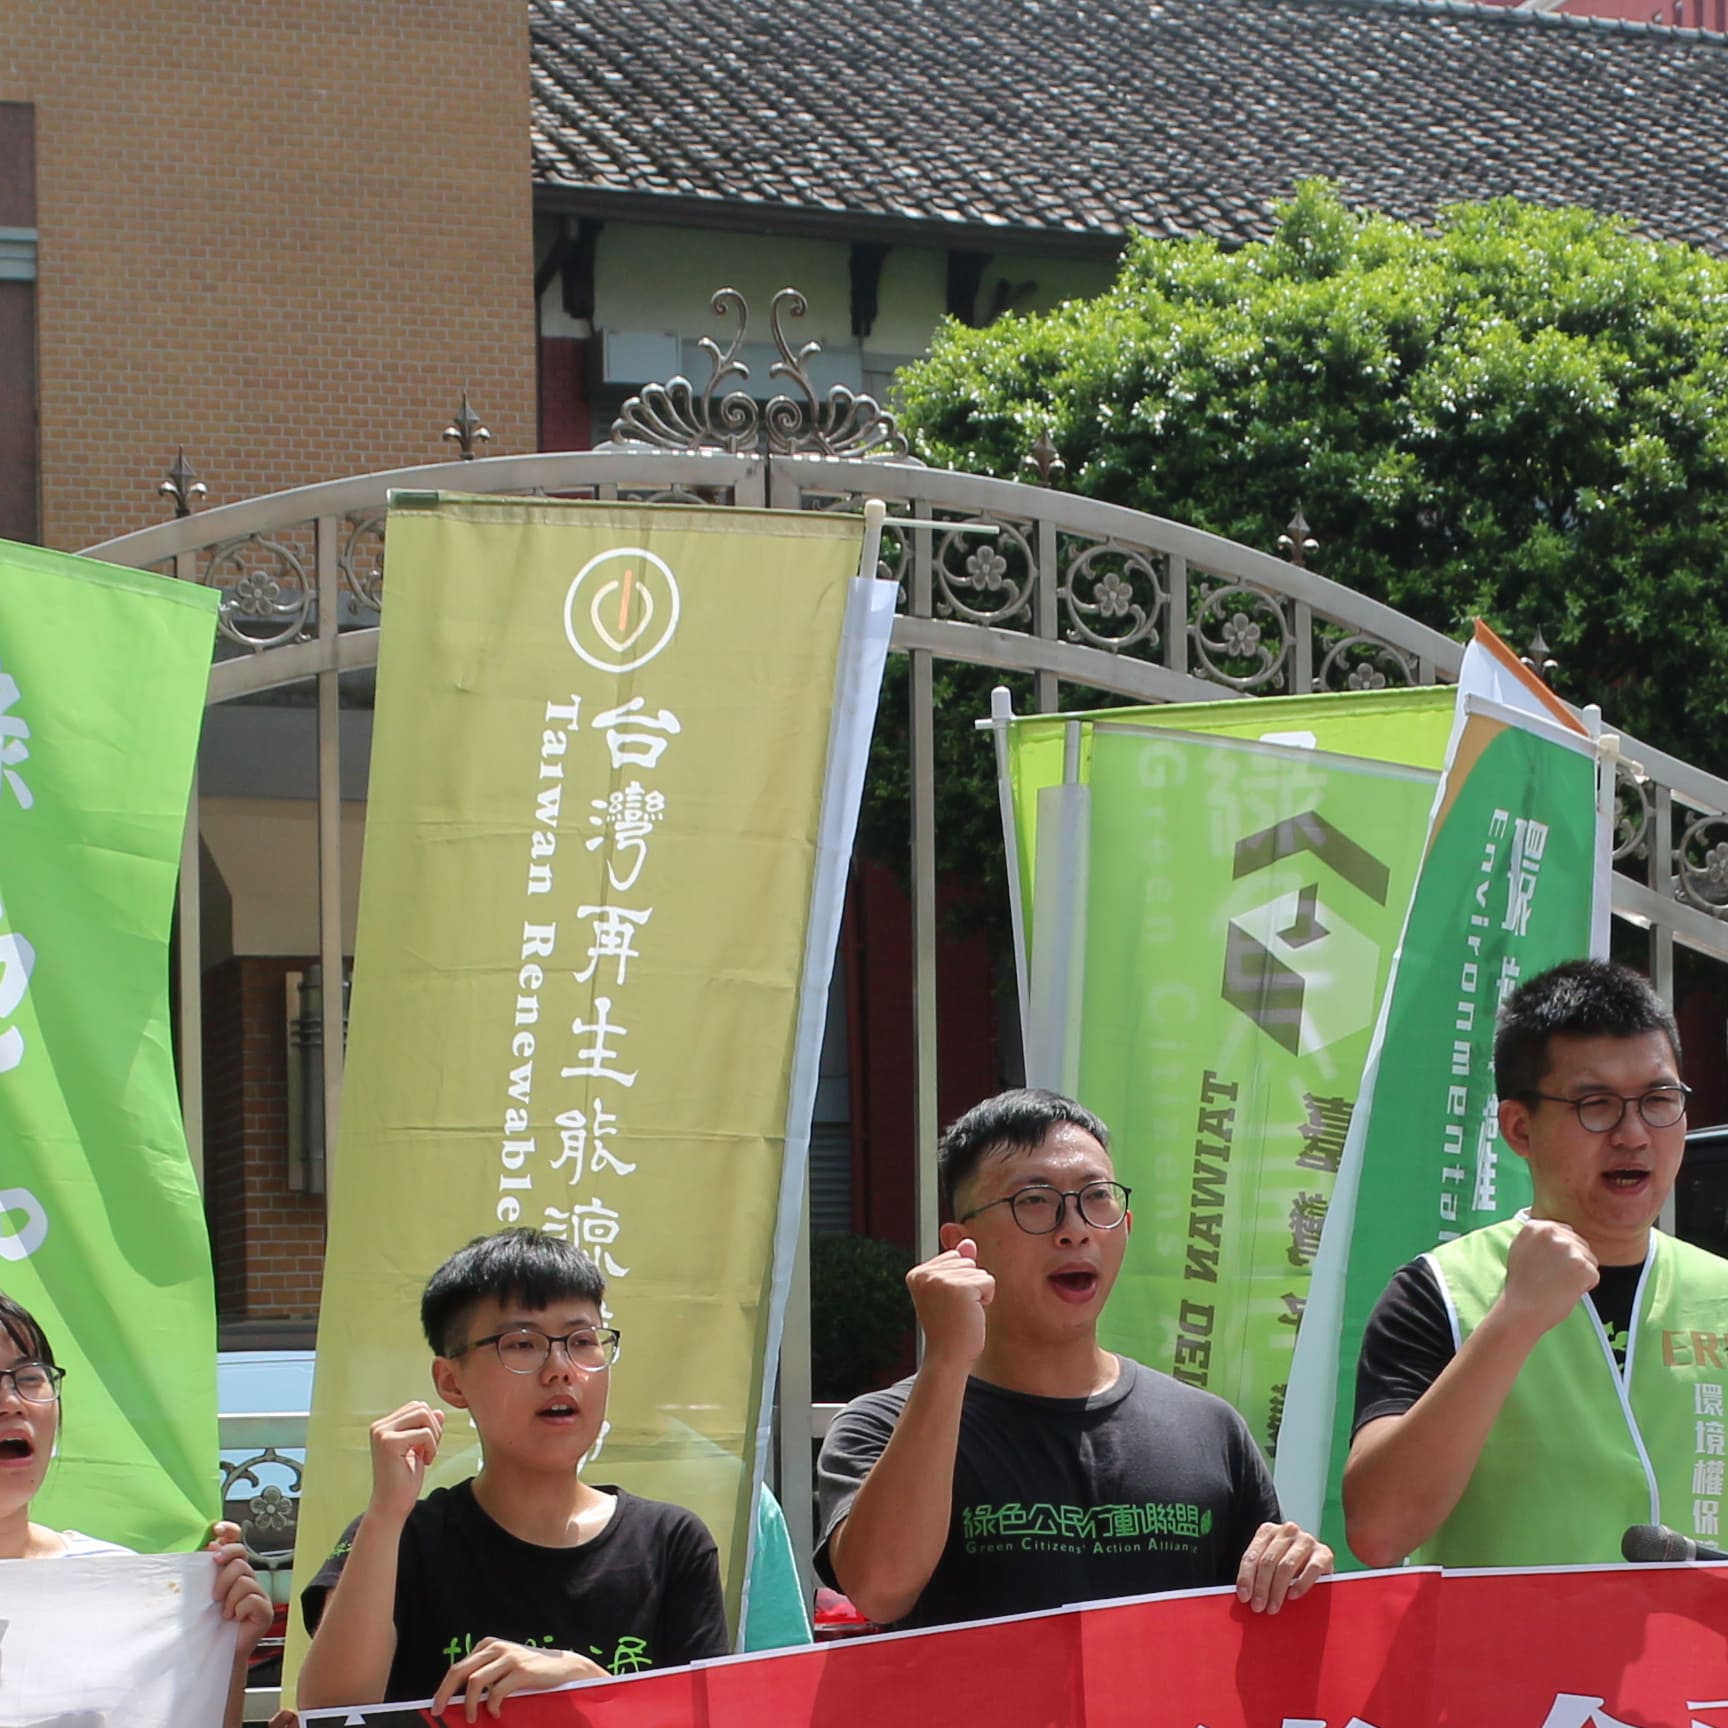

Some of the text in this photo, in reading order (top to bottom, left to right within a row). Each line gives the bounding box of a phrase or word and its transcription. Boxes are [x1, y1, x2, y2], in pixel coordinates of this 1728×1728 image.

[497, 694, 581, 1223] Taiwan Renewable
[962, 1503, 1200, 1538] 綠色公民行動聯盟
[966, 1541, 1013, 1554] Green
[1093, 1541, 1141, 1554] Action
